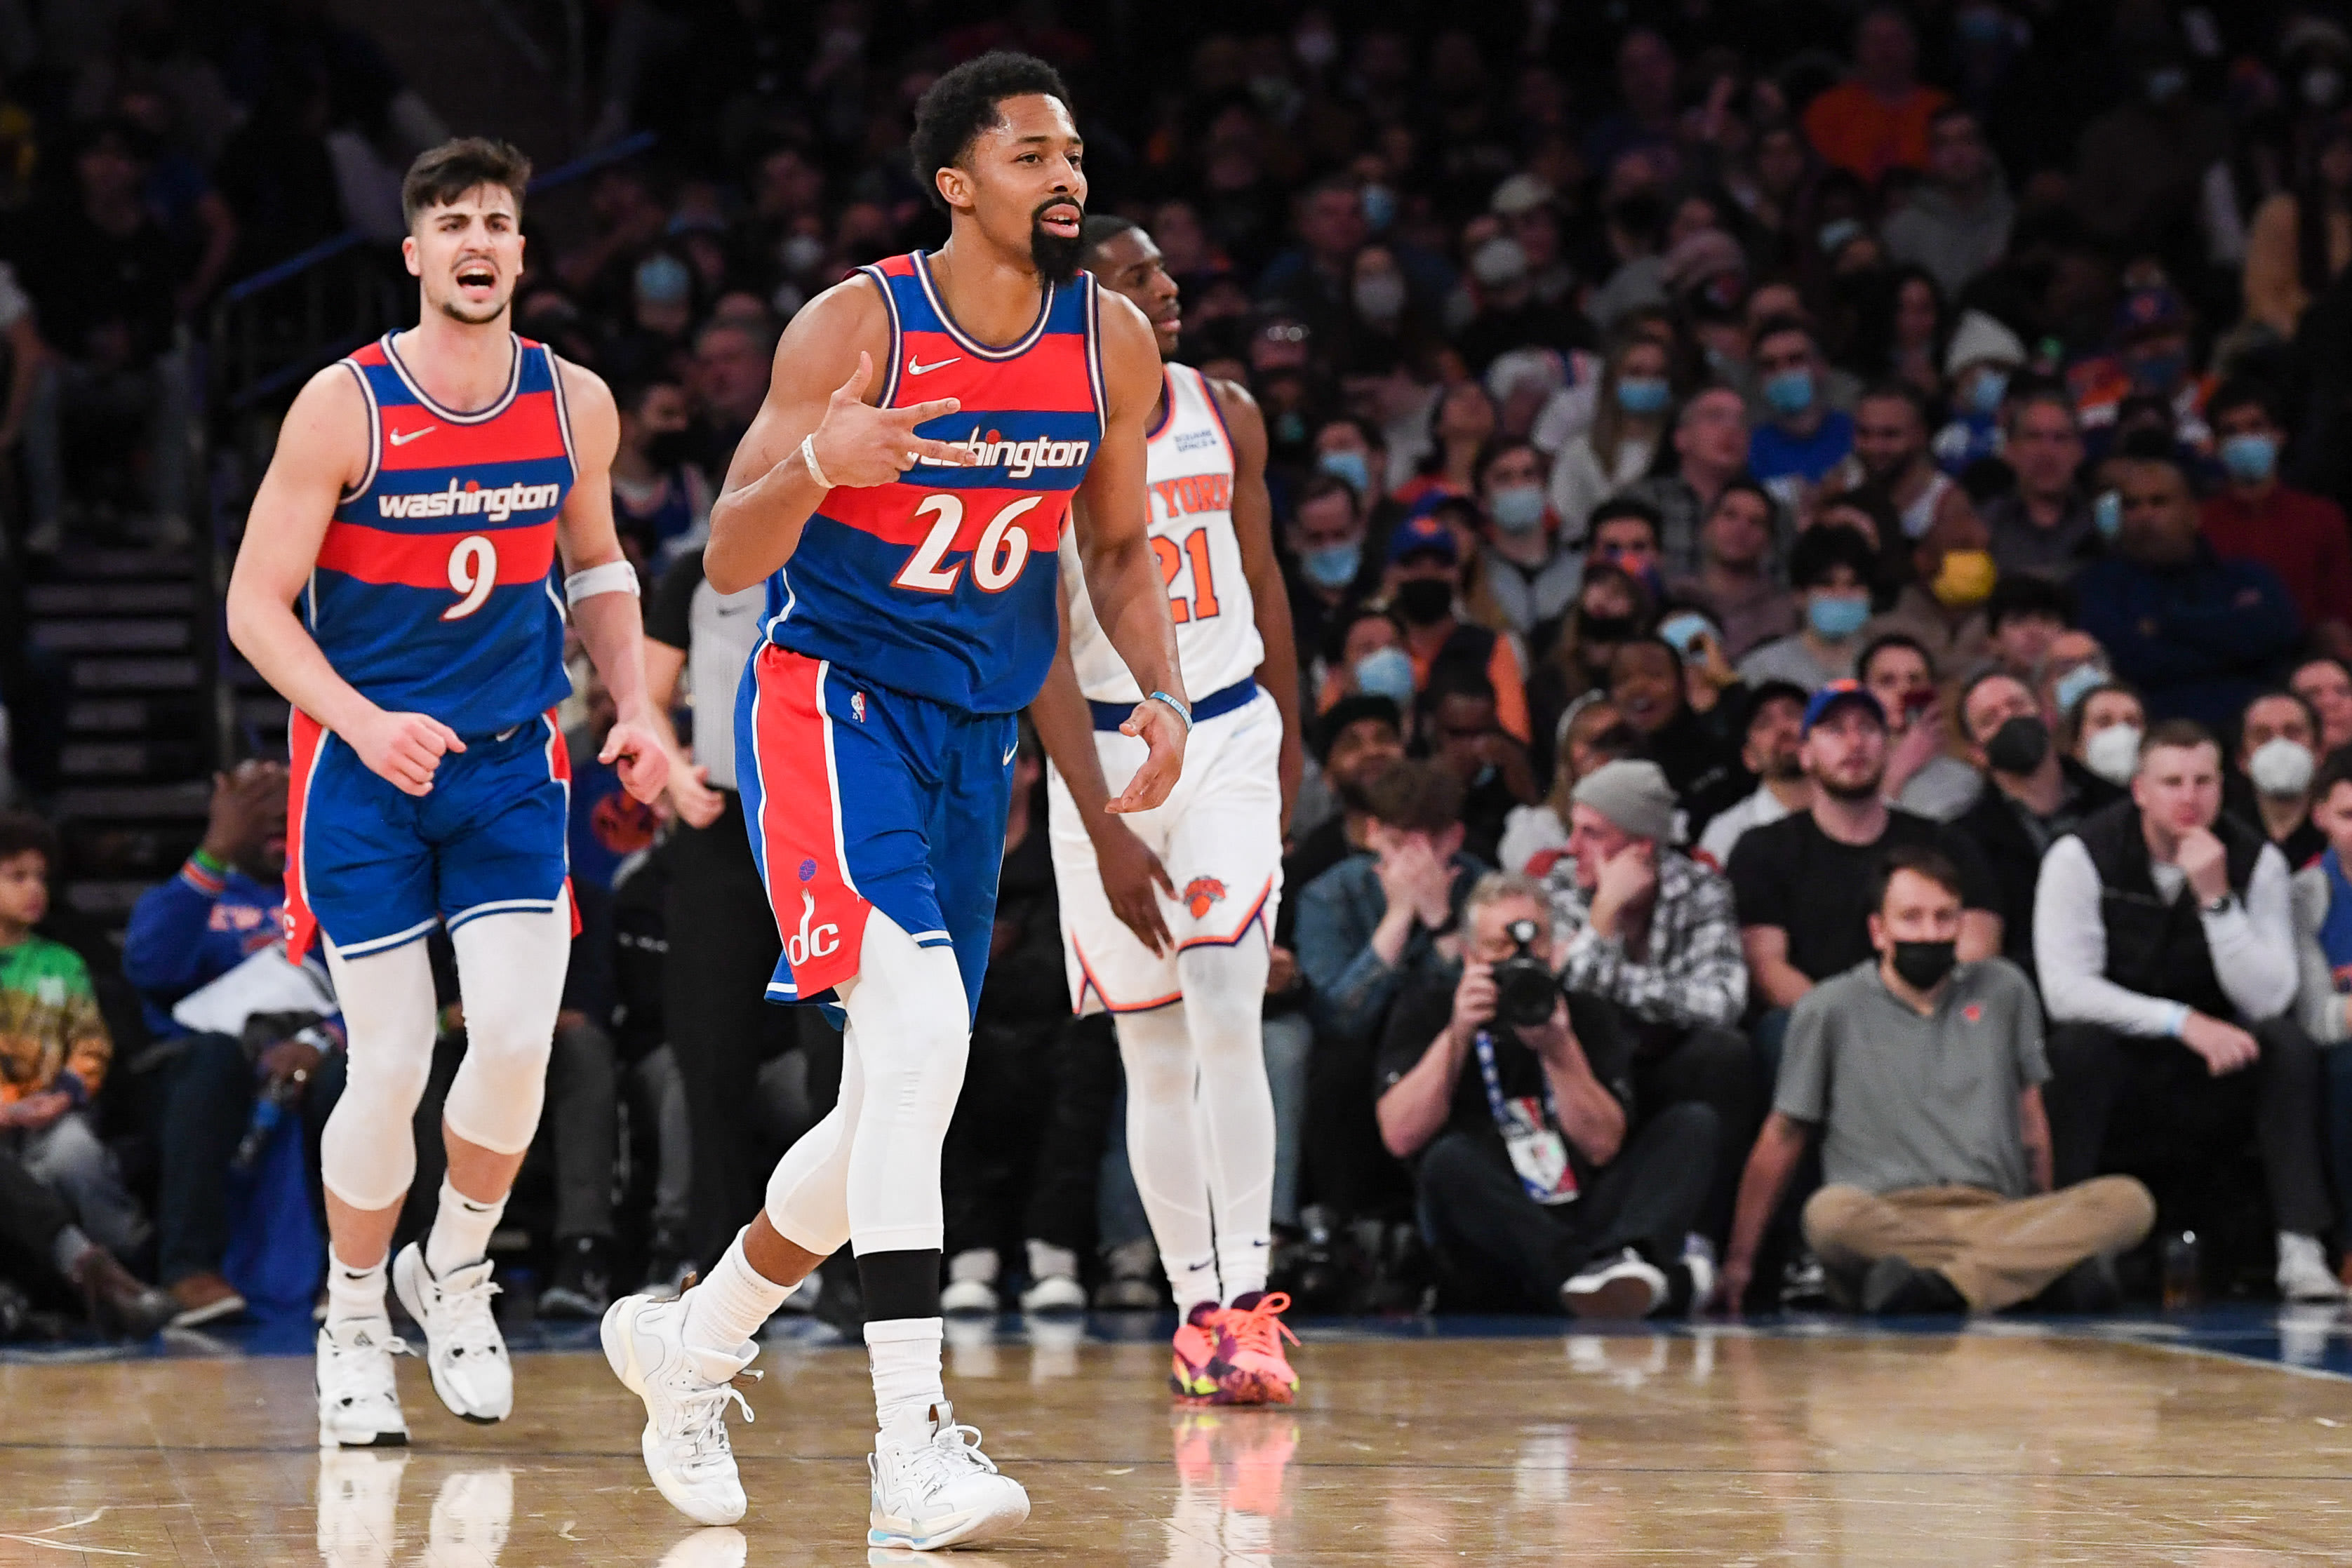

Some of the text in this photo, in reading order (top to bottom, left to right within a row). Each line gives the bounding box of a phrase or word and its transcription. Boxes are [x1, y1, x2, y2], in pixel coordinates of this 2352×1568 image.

[907, 424, 1090, 479] hington
[378, 477, 560, 523] washington
[1154, 472, 1231, 518] YORK
[439, 534, 497, 622] 9
[890, 492, 1044, 595] 26
[1149, 526, 1220, 625] 21
[788, 887, 840, 967] dc
